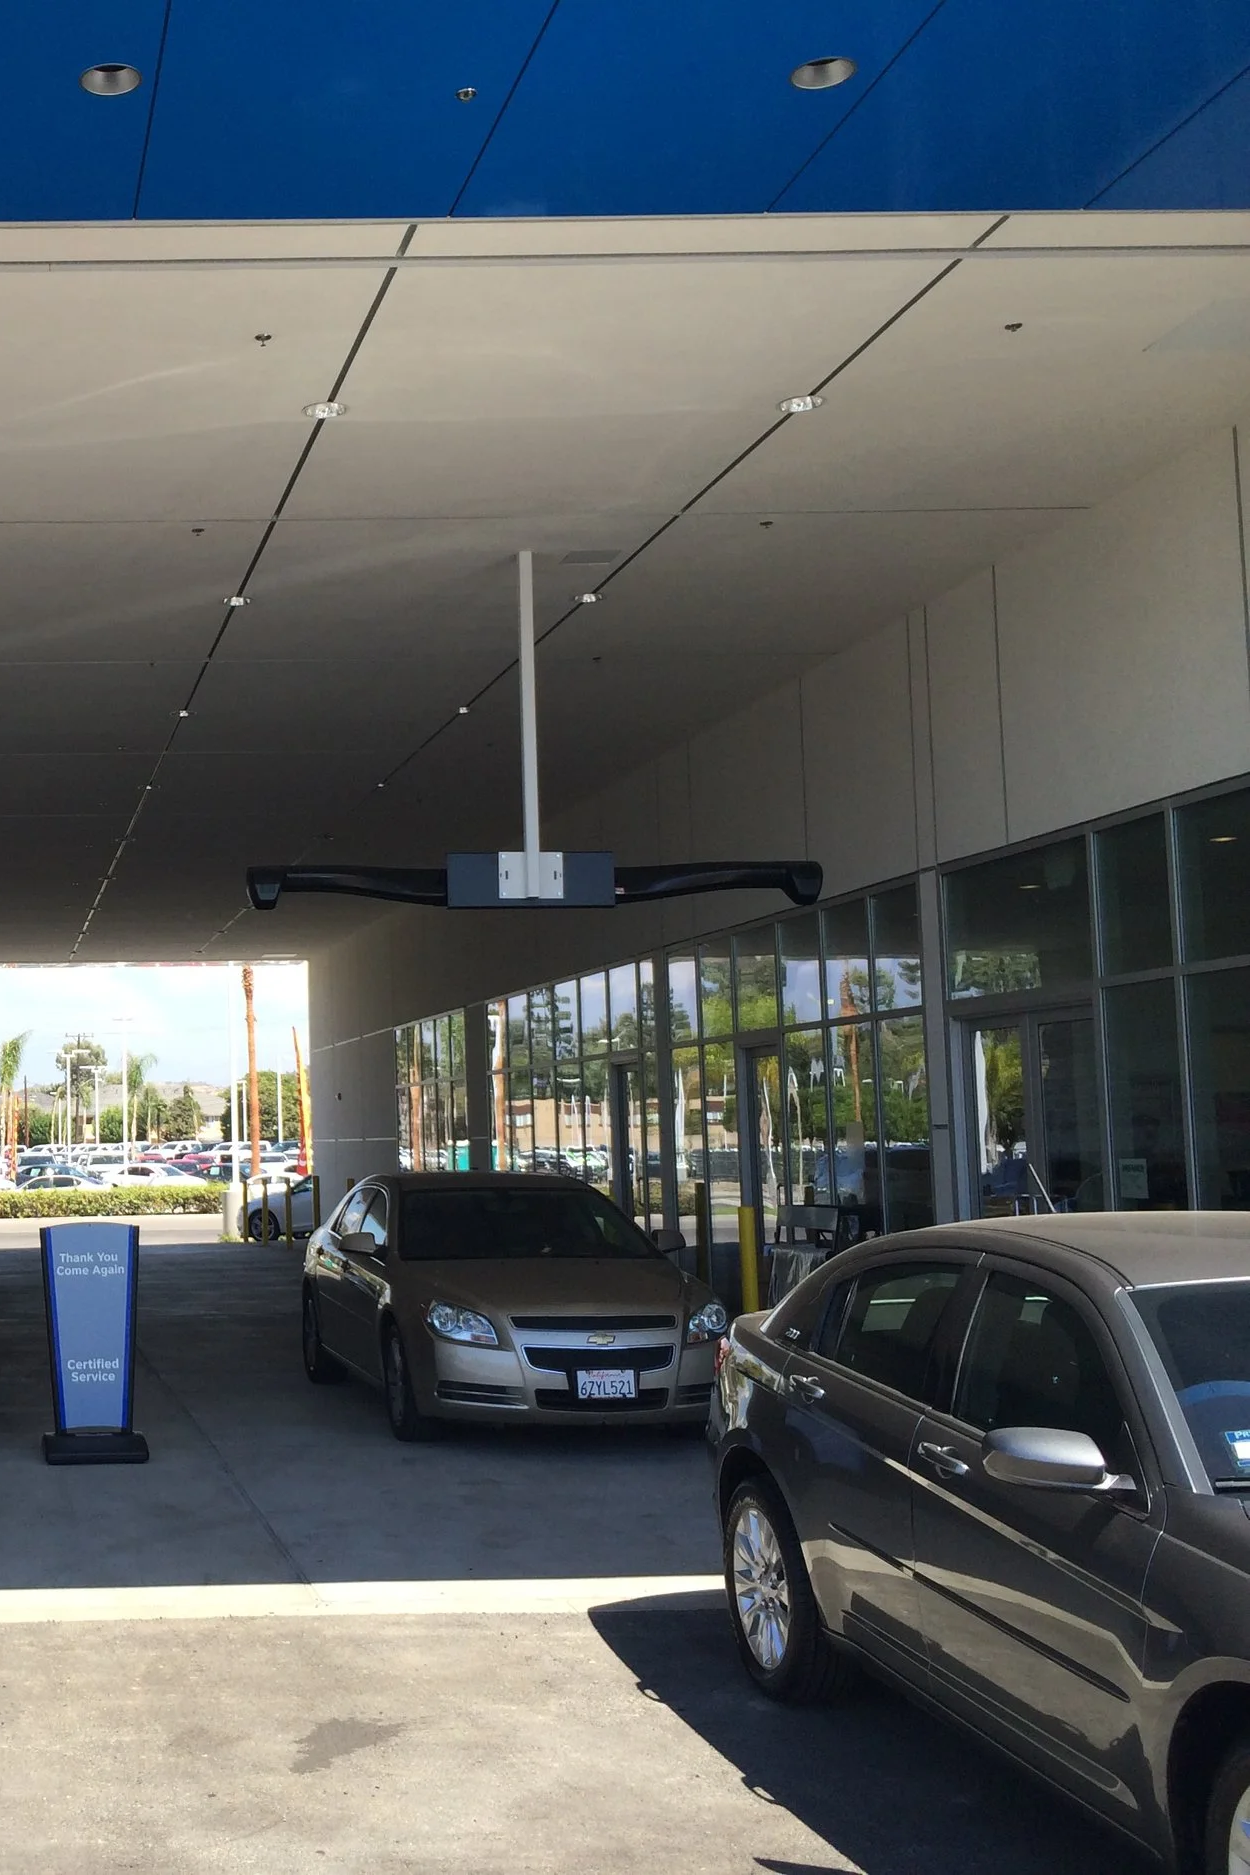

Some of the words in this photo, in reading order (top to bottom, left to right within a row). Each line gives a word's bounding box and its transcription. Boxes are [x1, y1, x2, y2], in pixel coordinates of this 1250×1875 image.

[59, 1252, 94, 1263] Thank
[97, 1252, 118, 1262] You
[56, 1266, 89, 1276] Come
[92, 1265, 125, 1277] Again
[67, 1358, 119, 1370] Certified
[71, 1371, 116, 1382] Service
[580, 1380, 634, 1396] 6ZYL521
